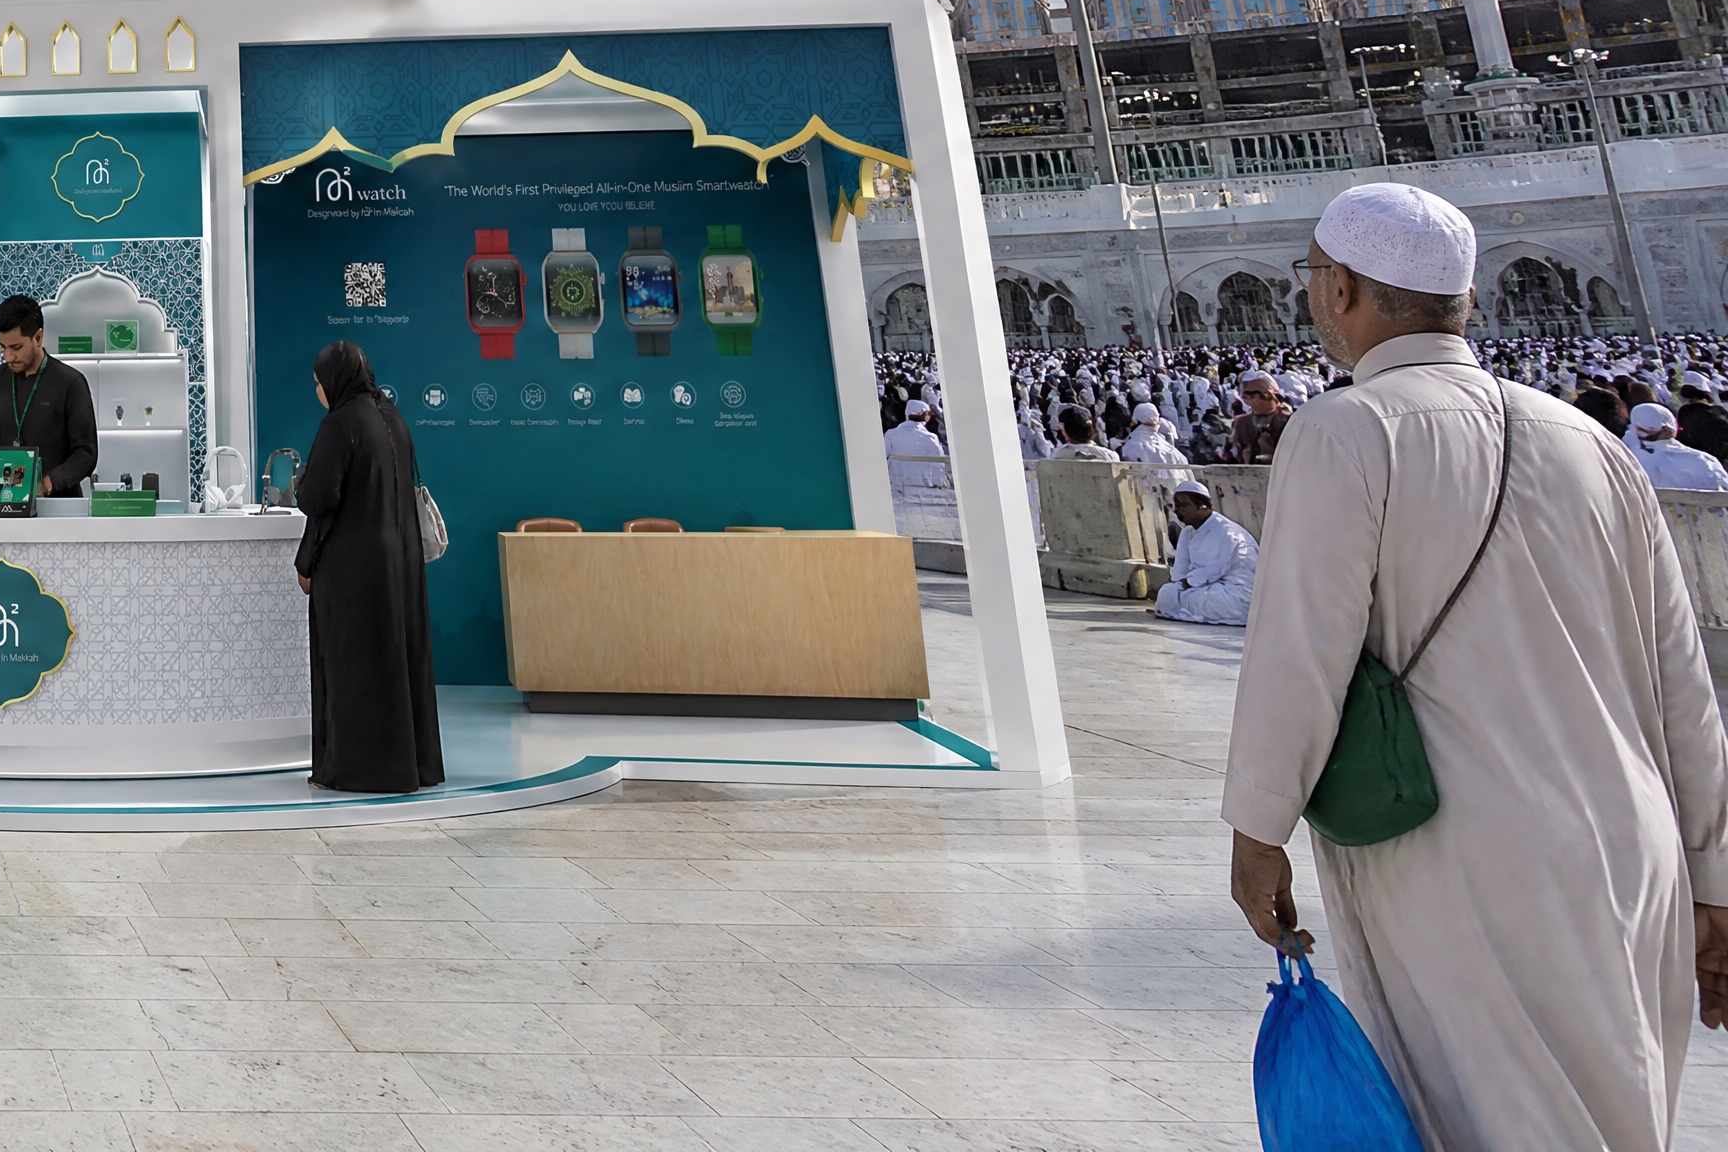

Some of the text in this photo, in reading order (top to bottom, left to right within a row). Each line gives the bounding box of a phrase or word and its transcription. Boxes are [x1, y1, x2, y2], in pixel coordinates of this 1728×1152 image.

[357, 185, 406, 201] watch
[471, 185, 513, 196] World's
[515, 184, 539, 196] First
[542, 183, 593, 197] Privileged
[596, 181, 651, 194] All-in-One
